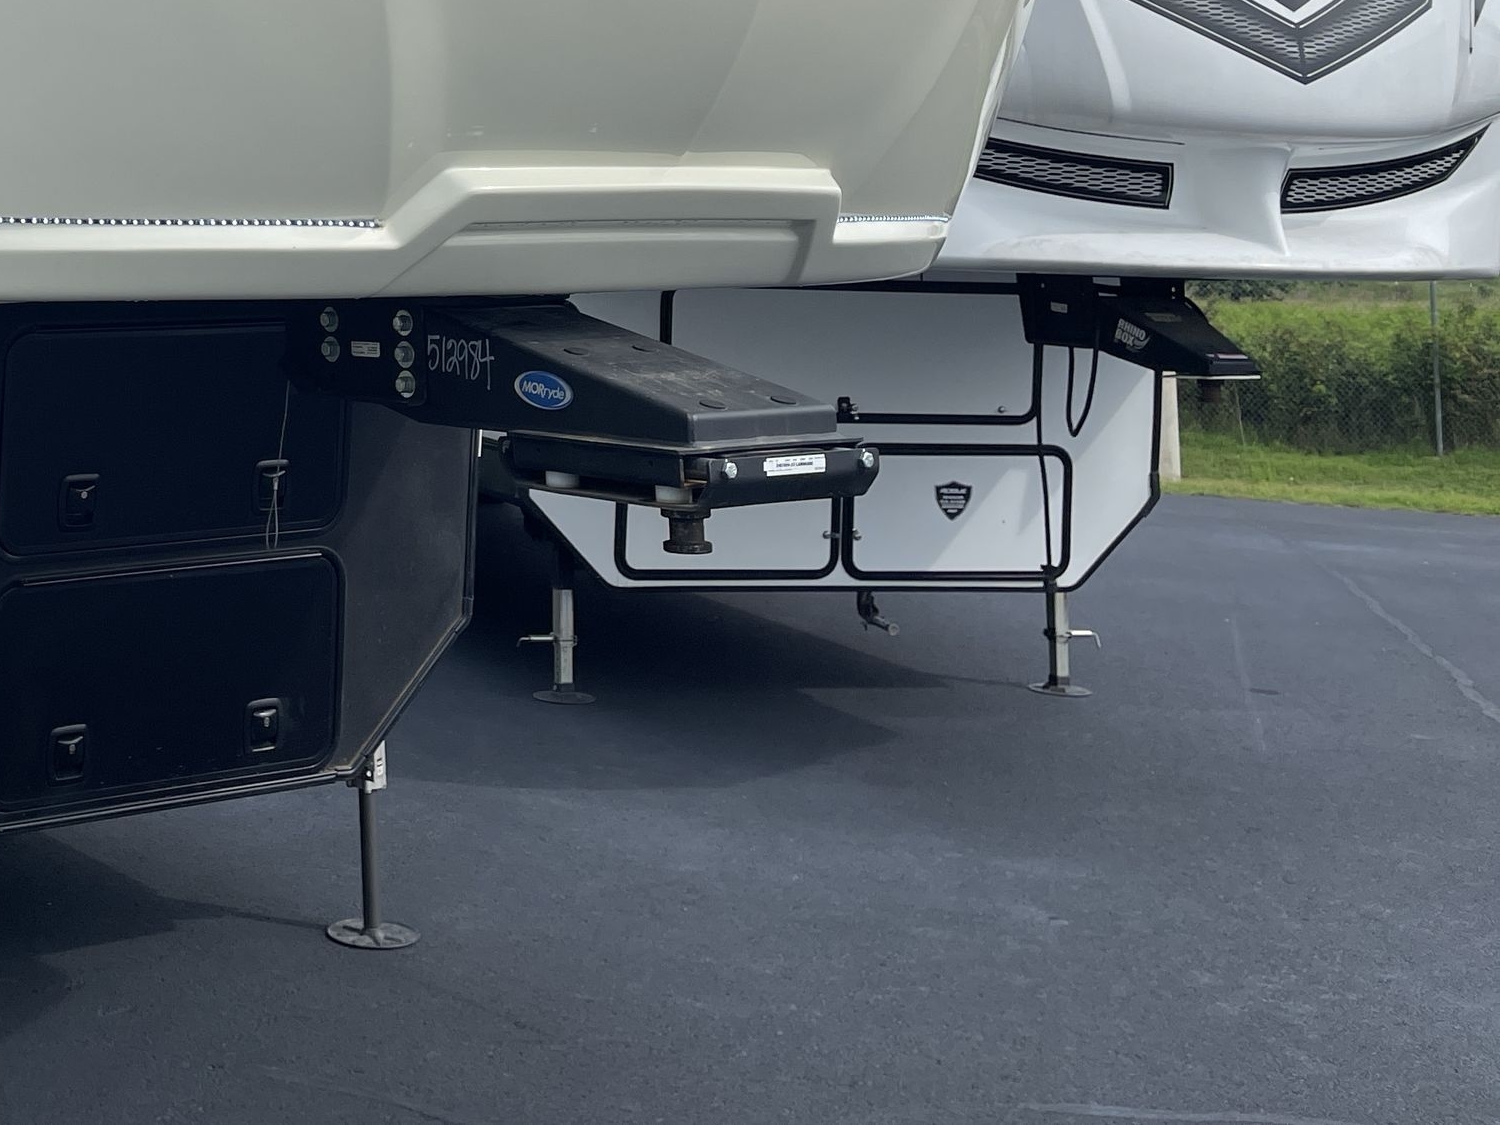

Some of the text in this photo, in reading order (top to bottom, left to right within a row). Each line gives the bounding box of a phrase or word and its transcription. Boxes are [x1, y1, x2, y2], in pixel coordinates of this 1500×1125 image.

[1114, 328, 1135, 347] BOX
[1117, 318, 1147, 341] RHINO
[427, 334, 496, 391] 512984
